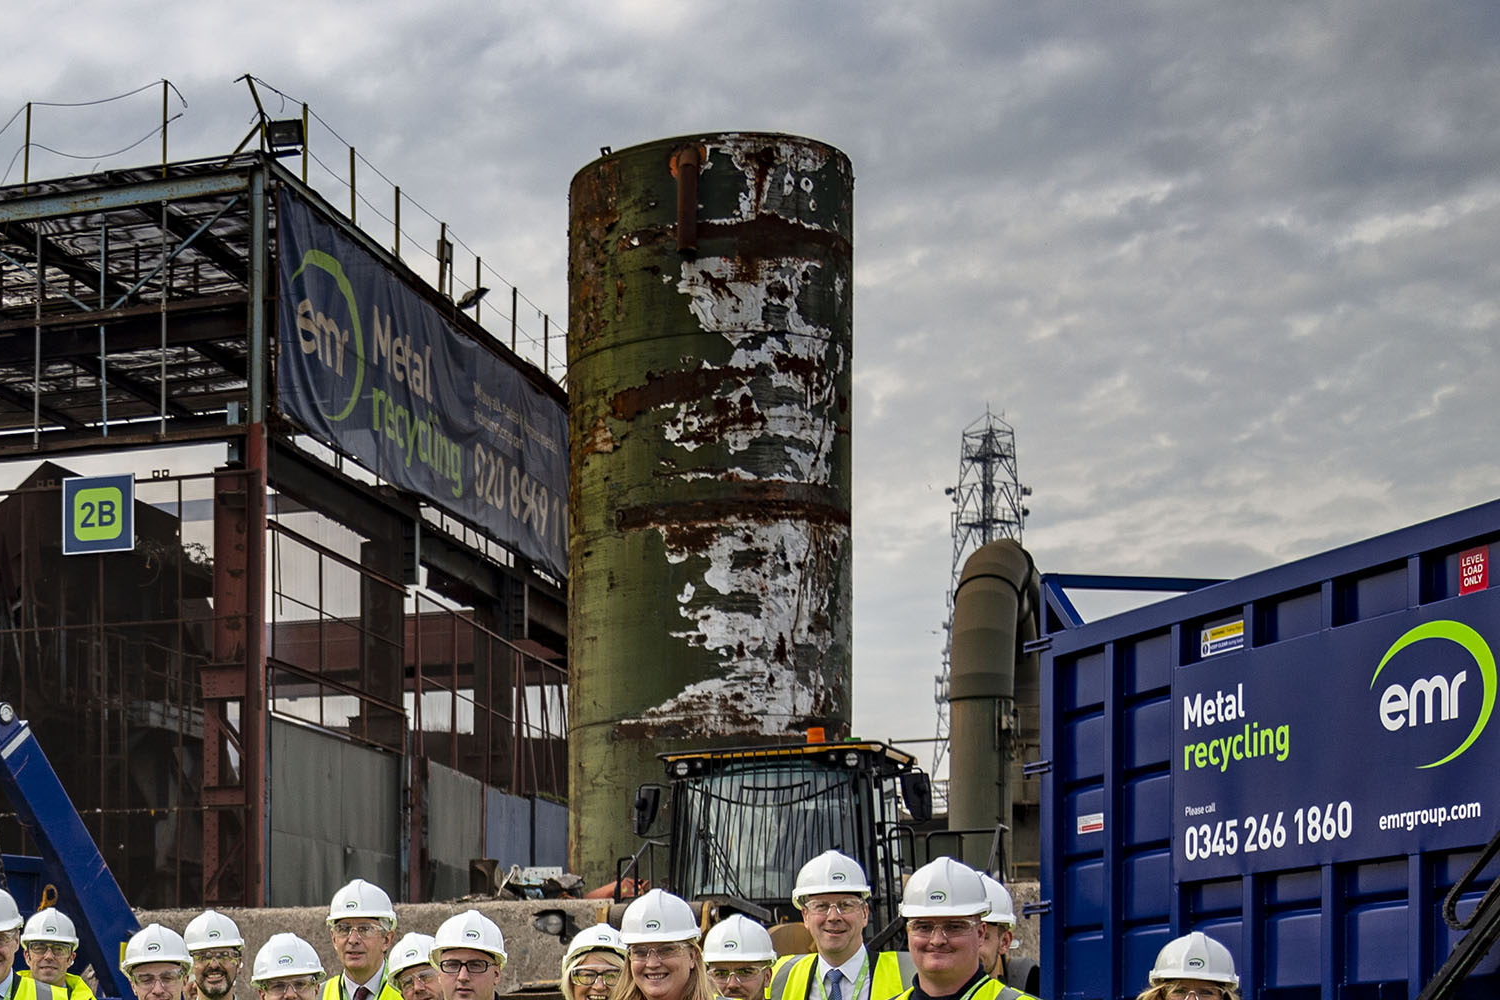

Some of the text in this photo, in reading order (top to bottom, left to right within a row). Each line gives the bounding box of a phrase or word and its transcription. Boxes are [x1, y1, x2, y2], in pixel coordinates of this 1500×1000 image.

[298, 299, 348, 377] emr
[373, 305, 433, 403] Metal
[372, 387, 463, 498] recycling
[80, 500, 116, 528] 2B
[1462, 553, 1484, 567] LEVEL
[1463, 563, 1483, 577] LOAD
[1463, 574, 1483, 587] ONLY
[1184, 683, 1245, 731] Metal
[1379, 670, 1467, 731] emr
[1184, 722, 1289, 773] recycling
[1185, 802, 1216, 816] Please call
[1185, 801, 1352, 861] 0345 266 1860
[1379, 802, 1481, 831] emrgroup.com
